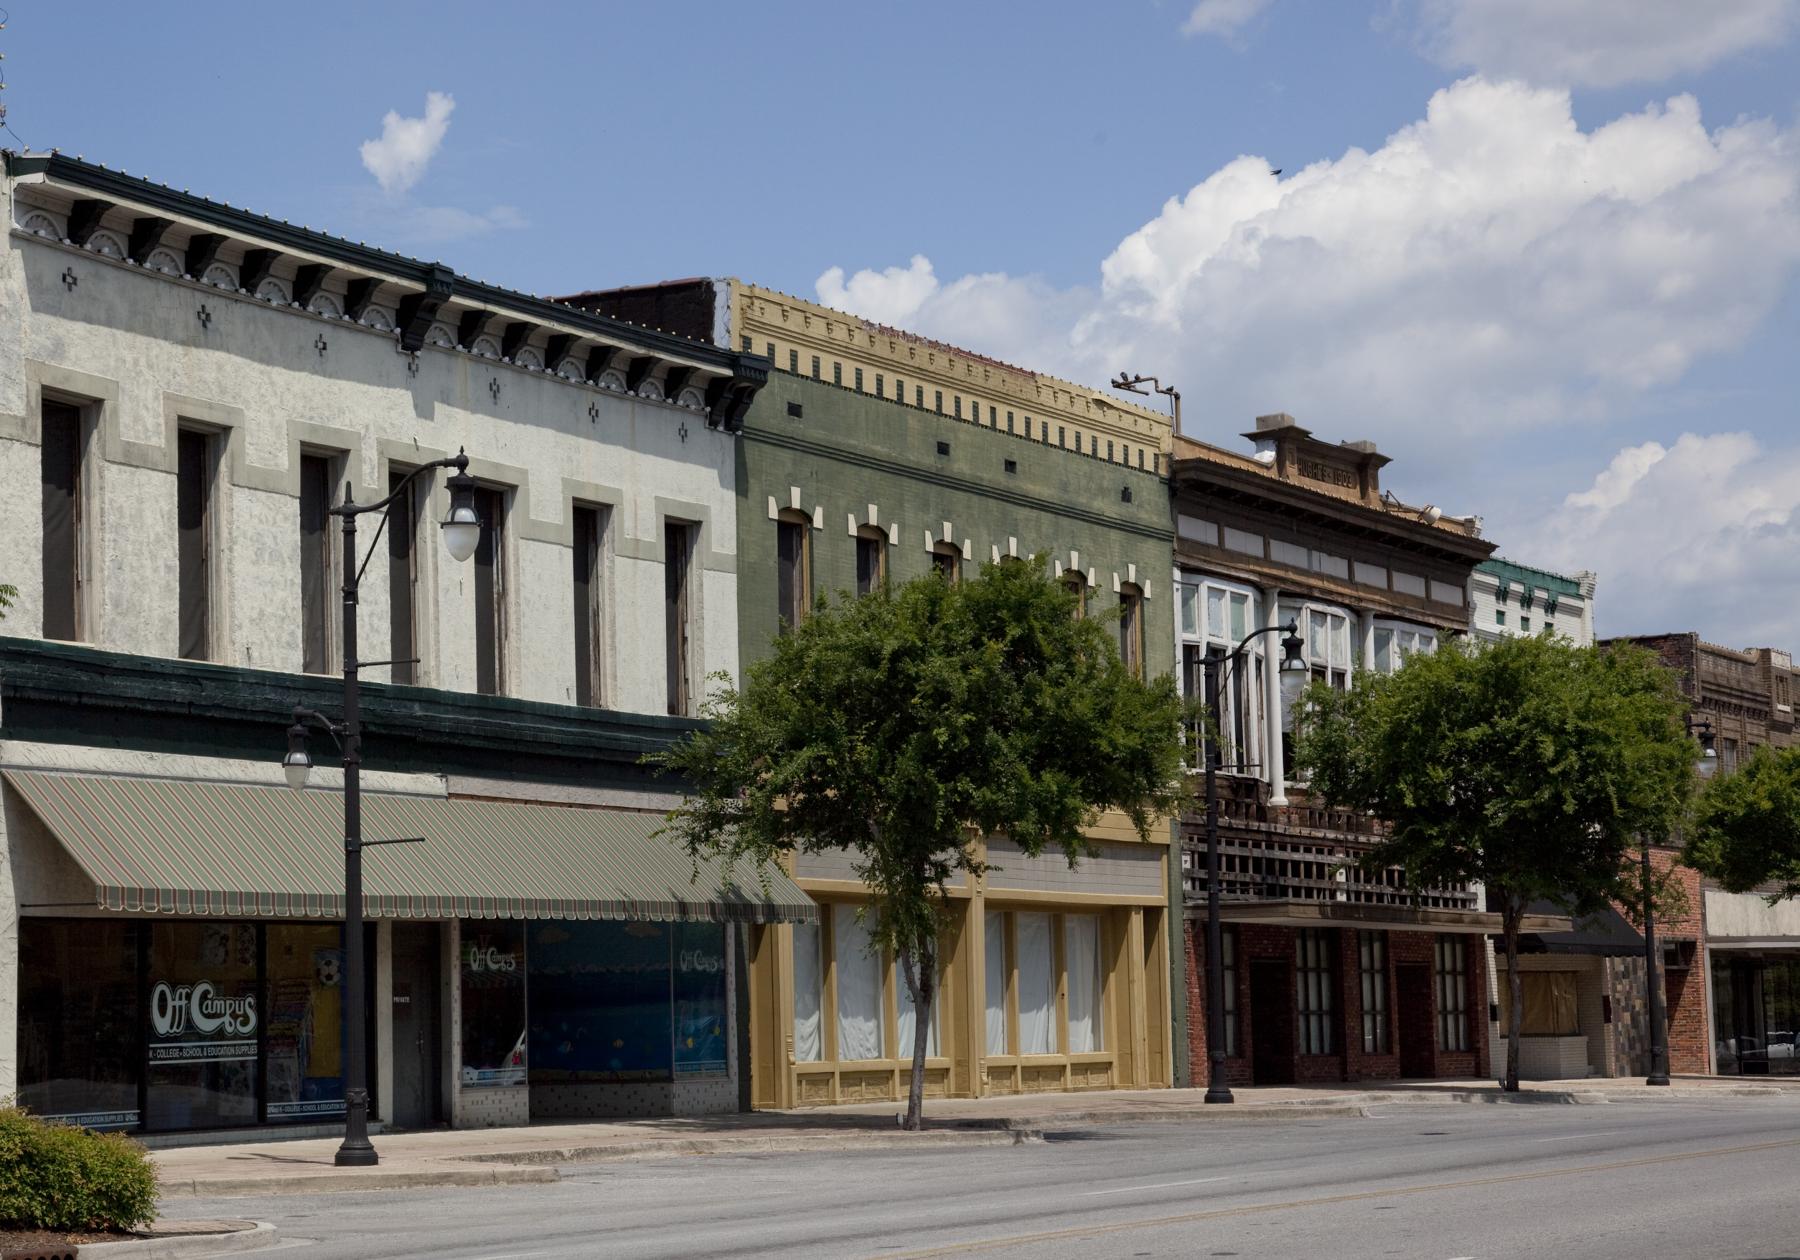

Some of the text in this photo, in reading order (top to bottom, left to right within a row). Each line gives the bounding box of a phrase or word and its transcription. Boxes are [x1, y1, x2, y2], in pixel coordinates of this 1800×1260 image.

[470, 946, 486, 971] Off
[680, 949, 694, 972] Off
[151, 979, 256, 1037] Off Campus
[157, 1048, 180, 1058] COLLEGE
[183, 1047, 203, 1057] SCHOOL
[208, 1046, 235, 1056] EDUCATION
[235, 1045, 257, 1055] SUPPLIES
